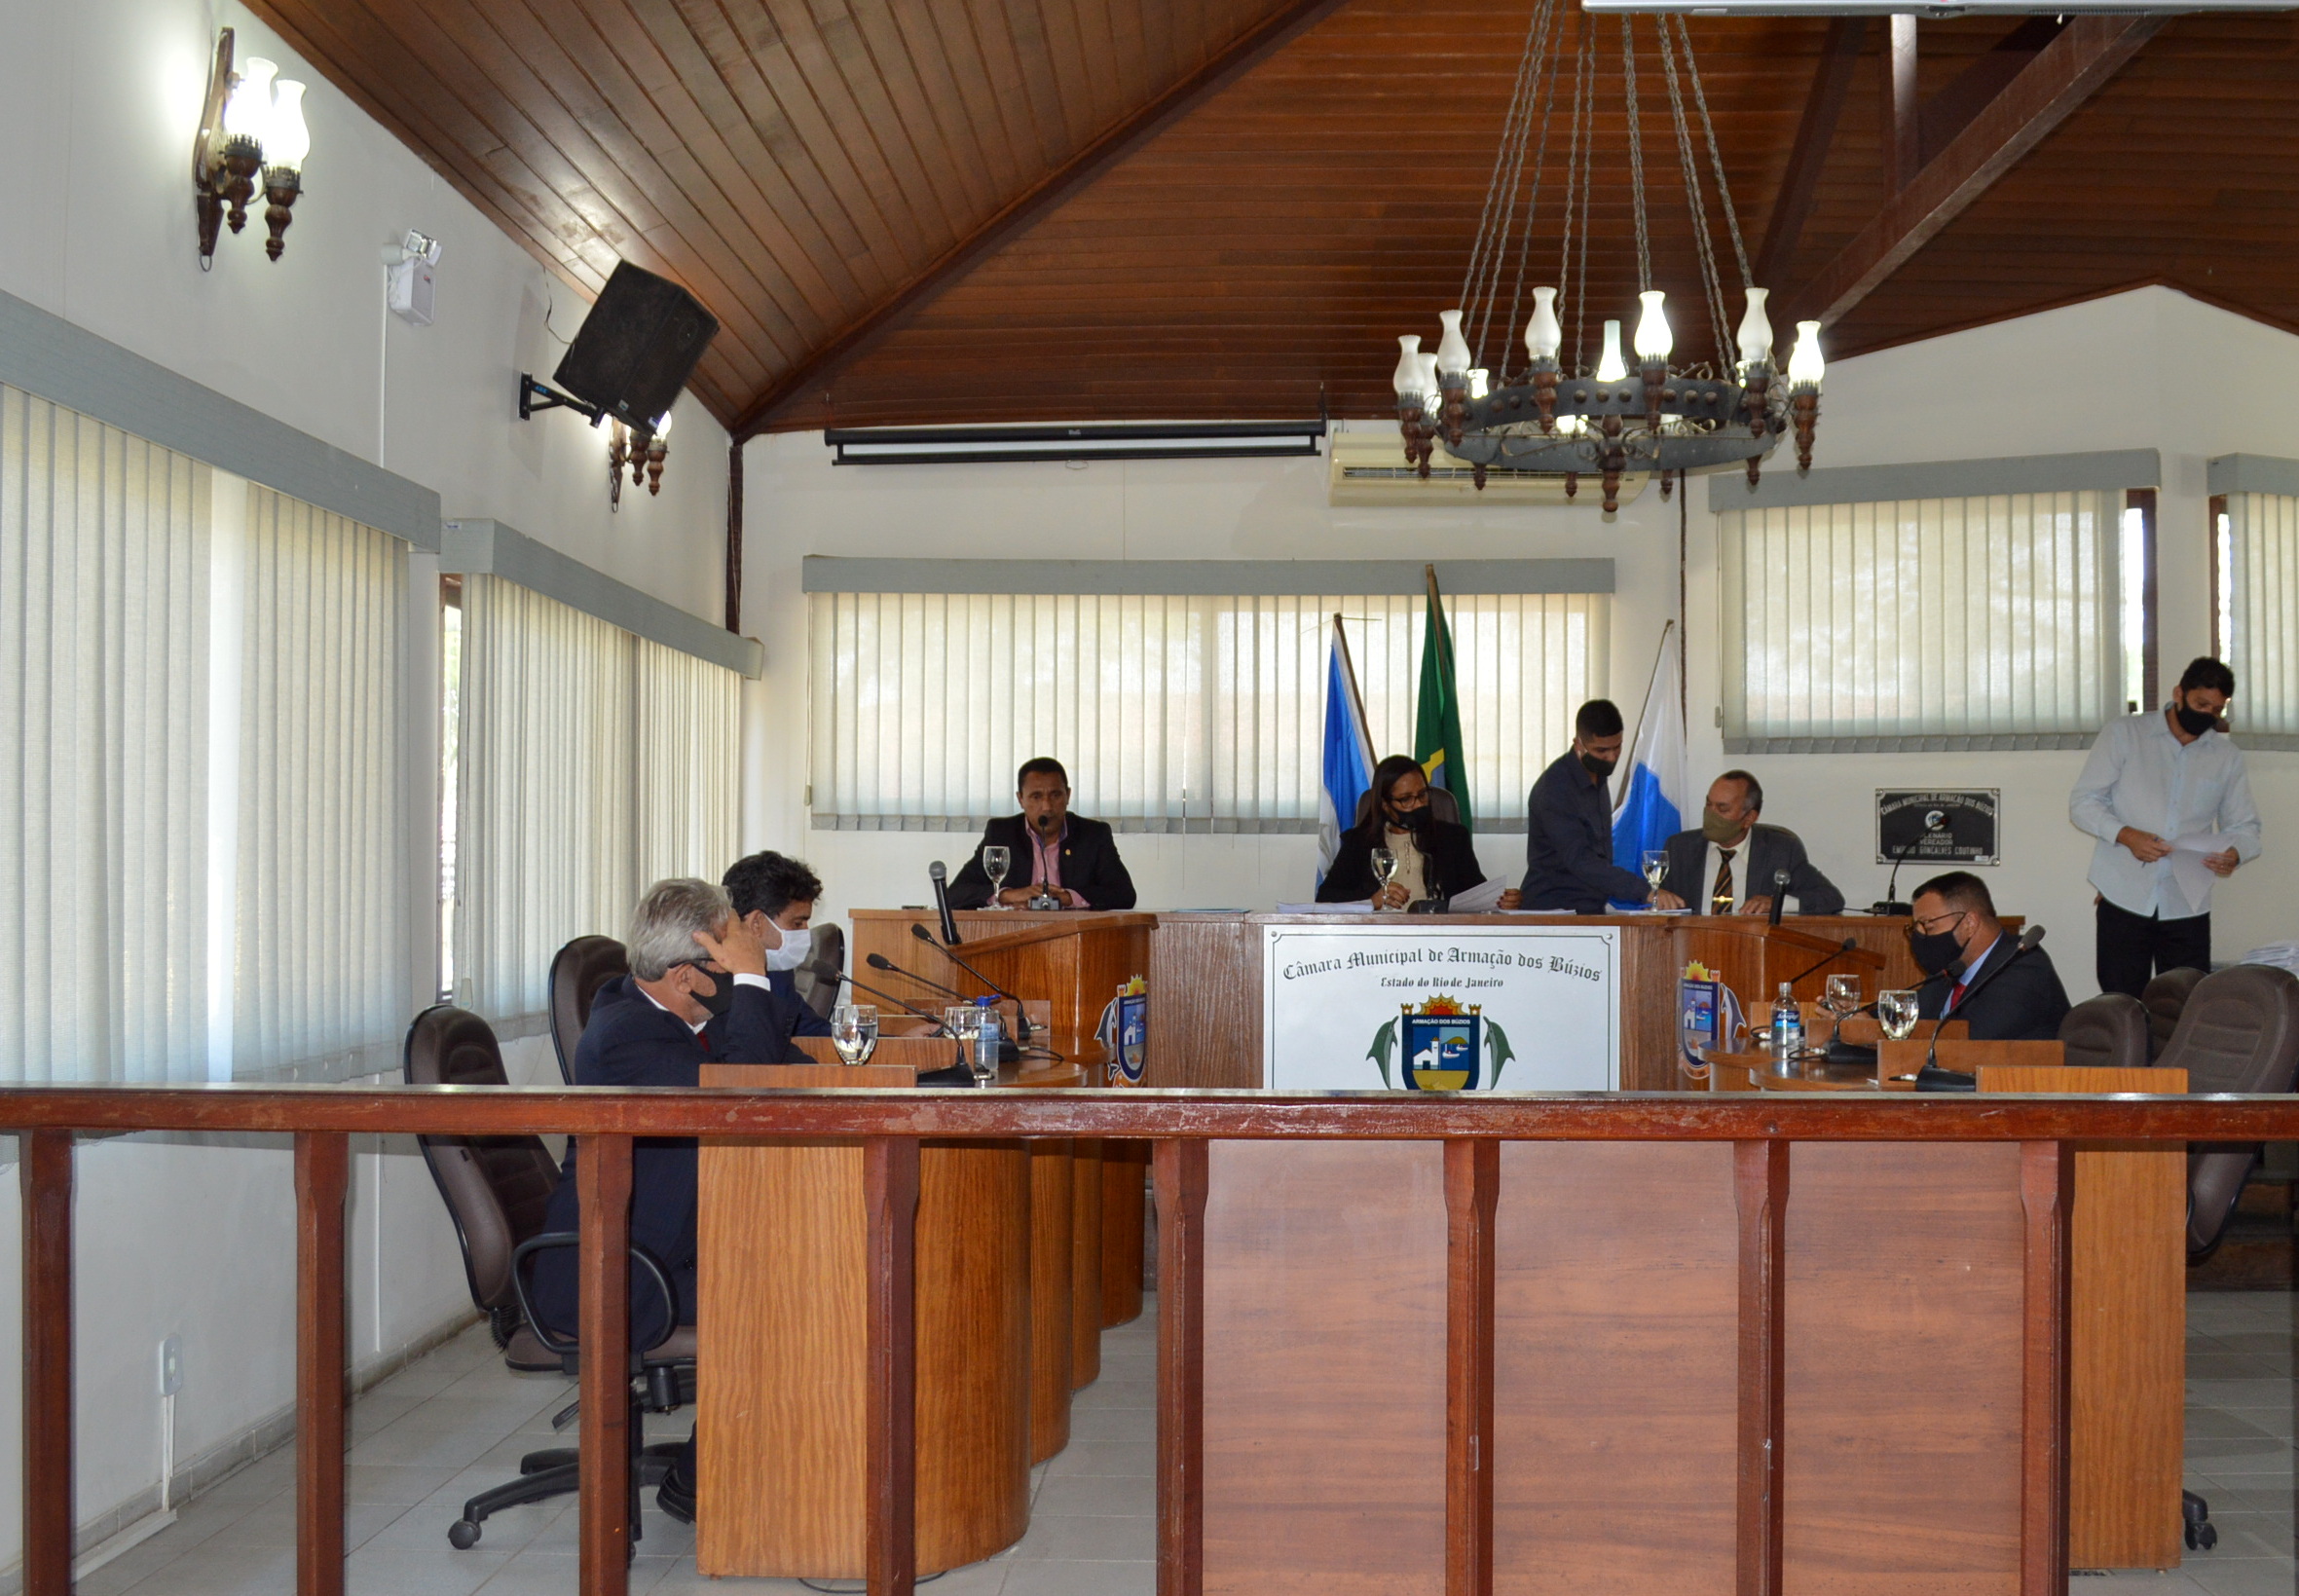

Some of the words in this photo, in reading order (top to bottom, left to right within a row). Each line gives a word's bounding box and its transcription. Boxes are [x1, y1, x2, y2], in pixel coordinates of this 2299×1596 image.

[1282, 958, 1342, 981] Câmara
[1346, 947, 1423, 970] Municipal
[1428, 948, 1444, 963] de
[1447, 946, 1512, 970] Armação
[1517, 952, 1544, 970] dos
[1547, 955, 1603, 983] Búzios
[1381, 977, 1414, 987] Estado
[1417, 977, 1429, 987] do
[1432, 977, 1449, 987] Rio
[1450, 977, 1463, 987] de
[1465, 977, 1504, 988] Janeiro
